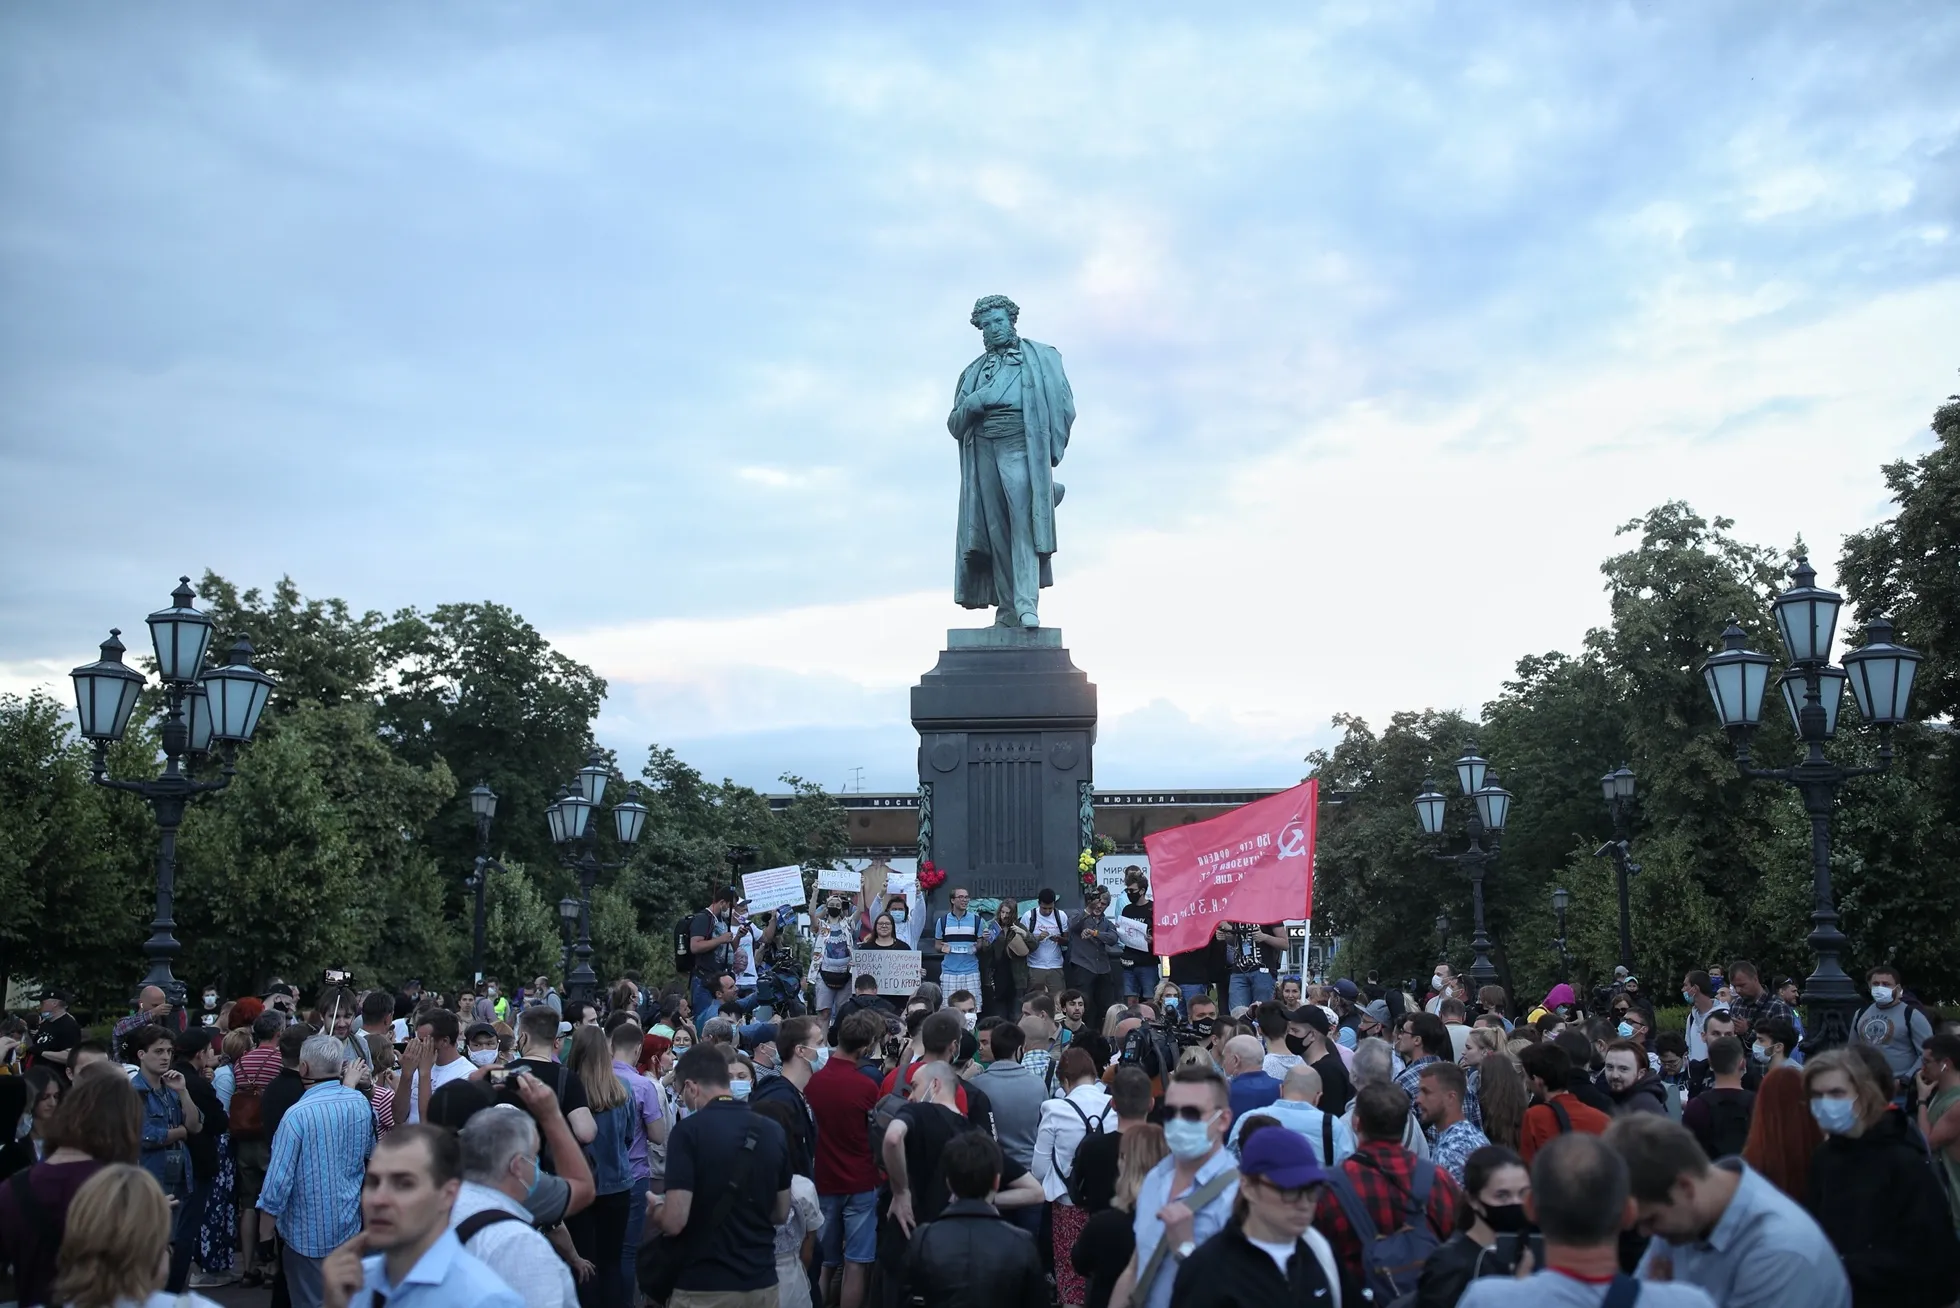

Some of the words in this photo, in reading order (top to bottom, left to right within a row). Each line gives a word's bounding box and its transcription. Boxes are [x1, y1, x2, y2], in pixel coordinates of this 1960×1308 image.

[821, 871, 852, 879] ПРОТЕСТ
[855, 952, 883, 963] ВОВКА
[856, 962, 883, 971] ВОВКА
